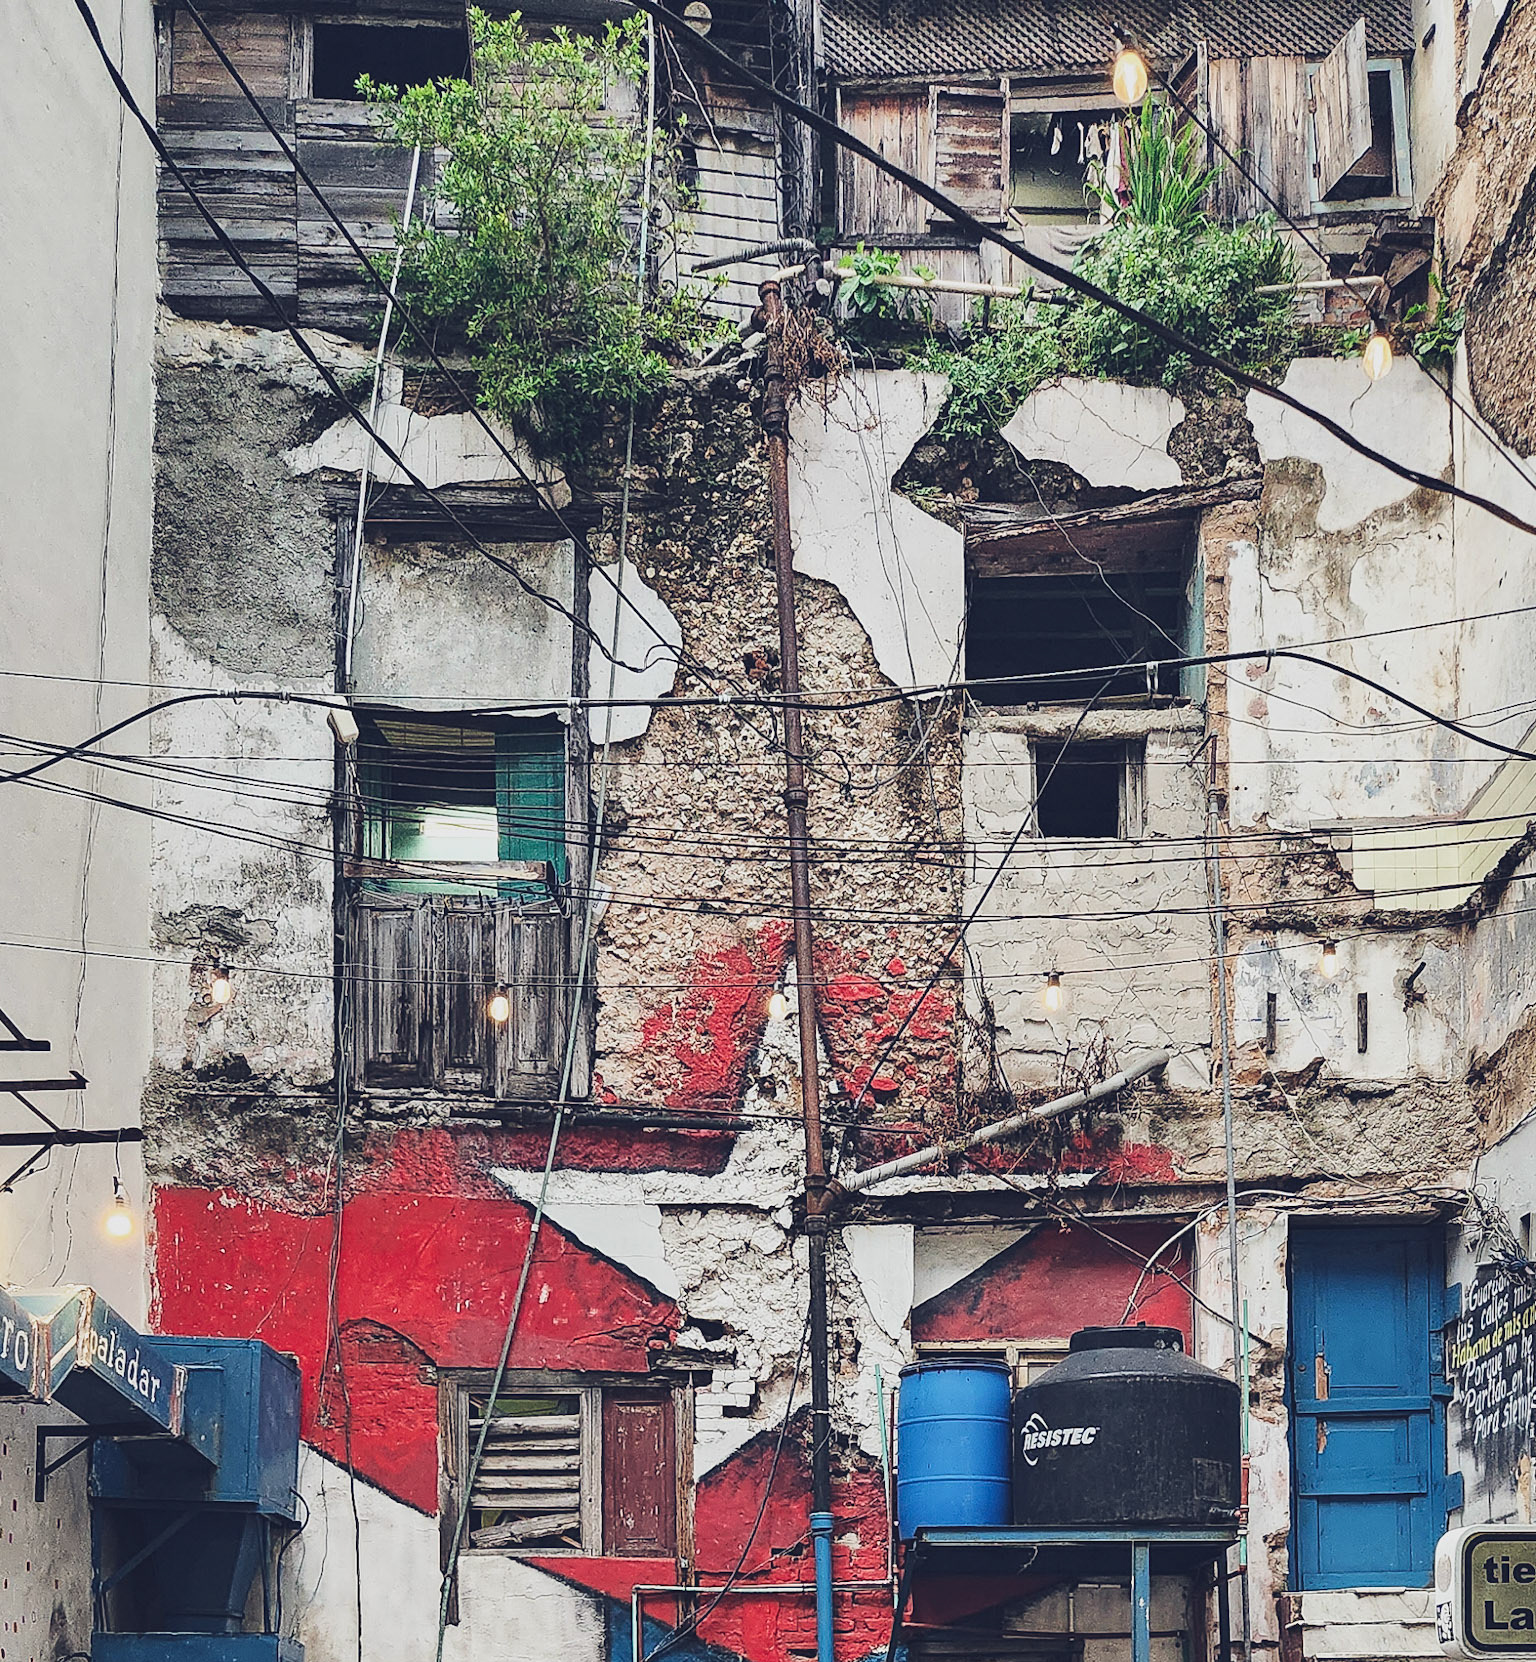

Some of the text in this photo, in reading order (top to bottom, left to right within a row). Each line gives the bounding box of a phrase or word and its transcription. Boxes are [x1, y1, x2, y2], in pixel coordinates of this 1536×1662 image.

[1480, 1293, 1509, 1331] calles
[1451, 1334, 1491, 1369] Habana
[1491, 1319, 1503, 1348] de
[1503, 1311, 1521, 1342] mis
[1462, 1328, 1533, 1392] Porque no he
[89, 1327, 161, 1403] paladar
[1462, 1371, 1507, 1419] Partido
[1023, 1426, 1097, 1451] RESISTEC
[1472, 1407, 1500, 1444] Para
[1484, 1600, 1535, 1630] La
